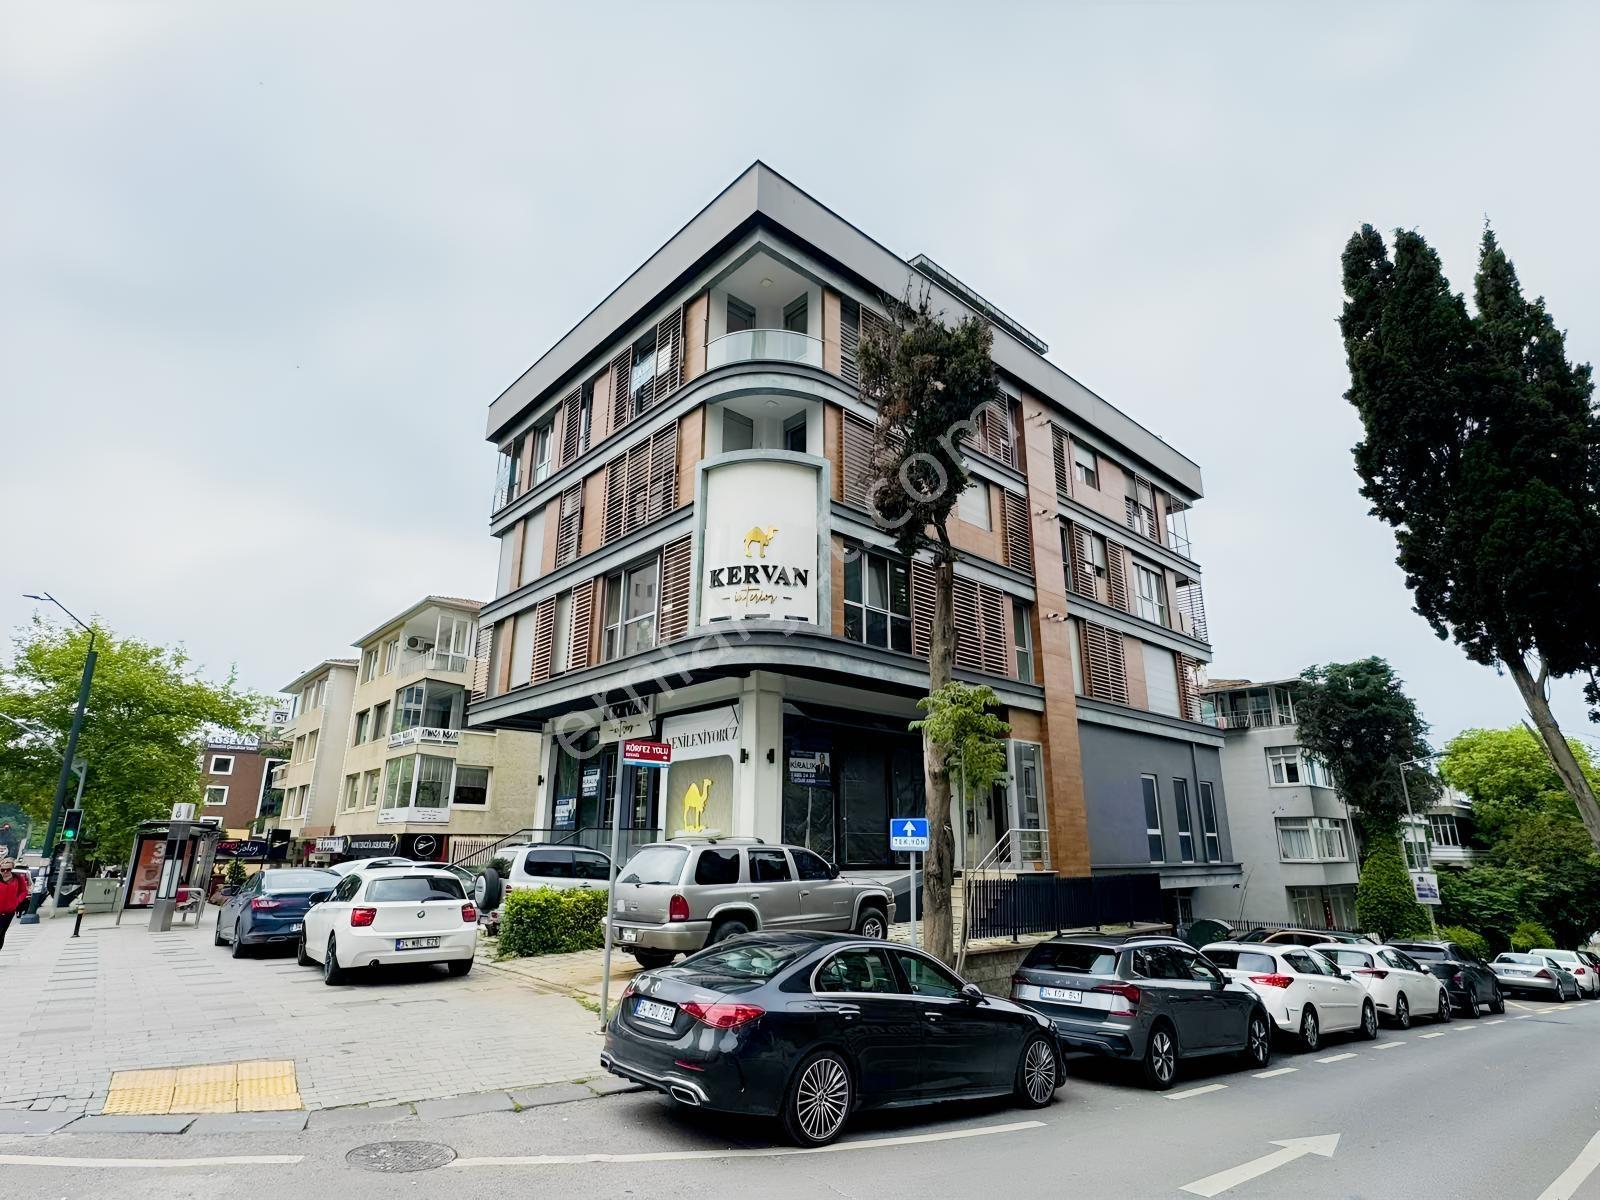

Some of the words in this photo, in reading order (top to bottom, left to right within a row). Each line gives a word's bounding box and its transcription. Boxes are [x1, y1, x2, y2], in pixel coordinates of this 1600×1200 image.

[709, 565, 809, 588] KERVAN
[625, 744, 650, 753] KÖRFEZ
[652, 746, 669, 755] YOLU
[665, 726, 738, 750] YENİLENİYORUZ
